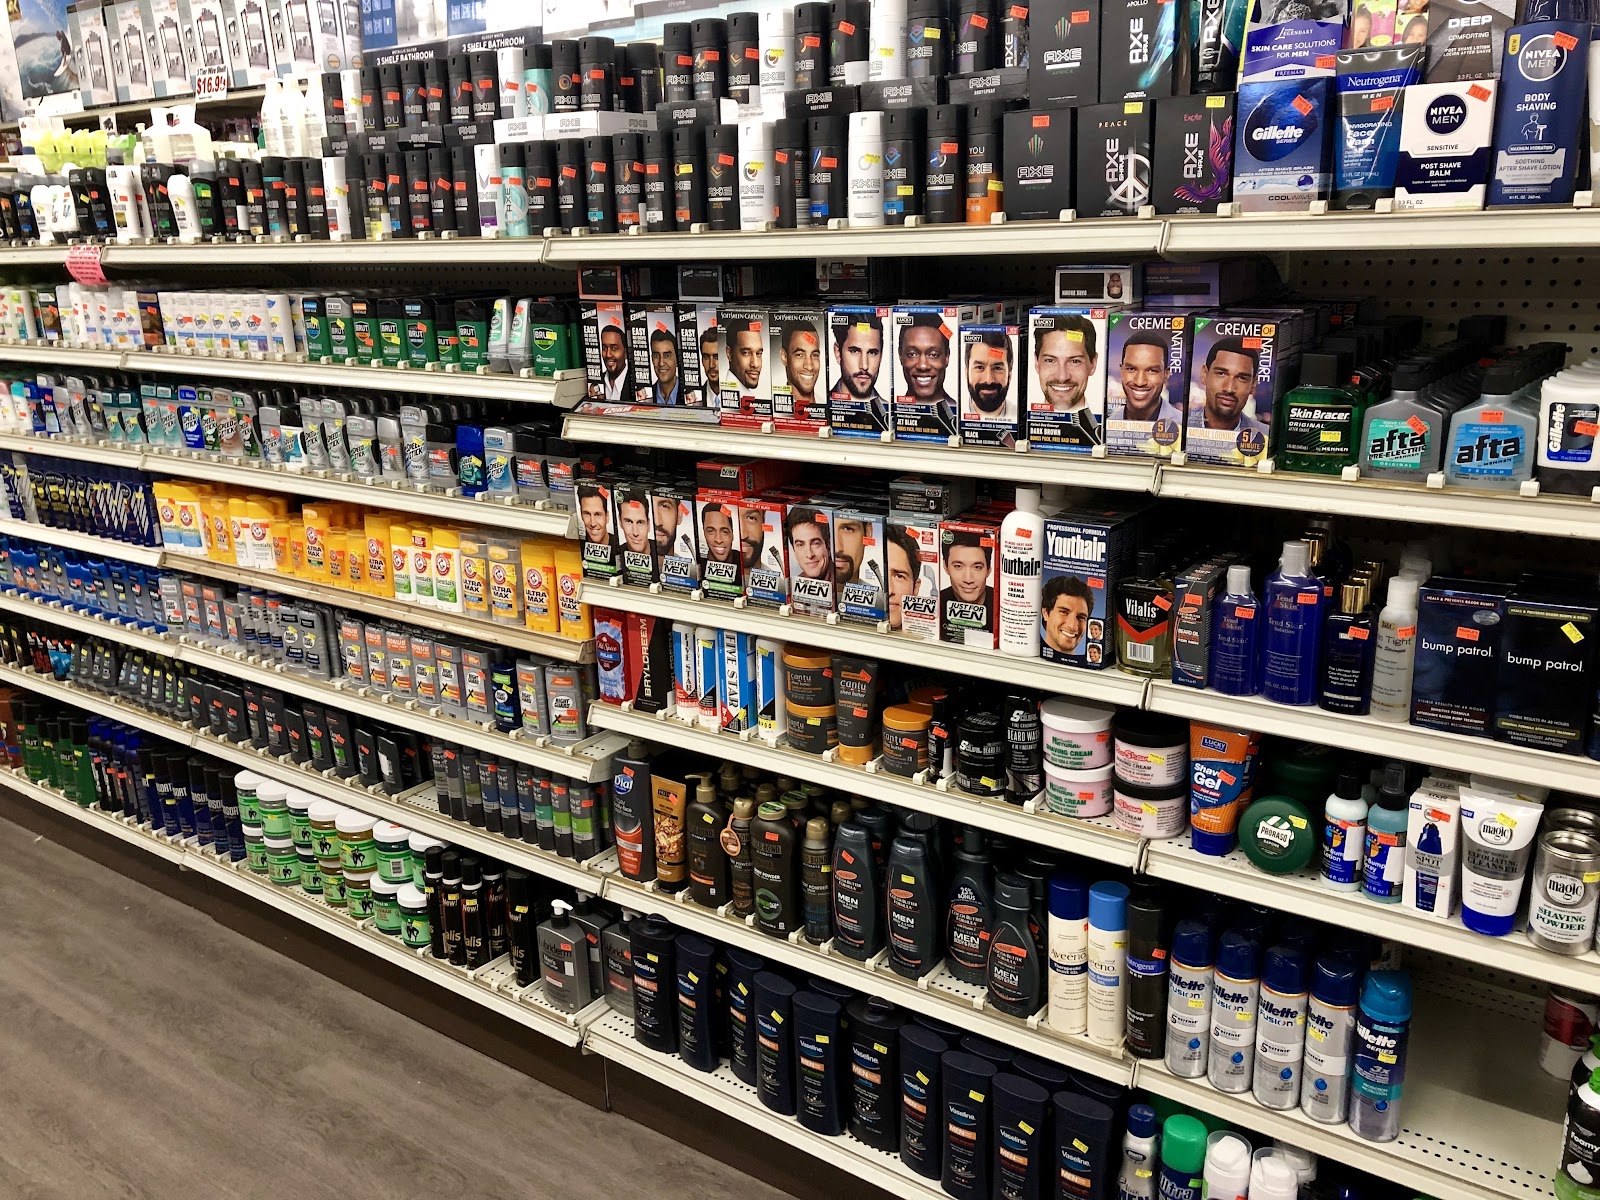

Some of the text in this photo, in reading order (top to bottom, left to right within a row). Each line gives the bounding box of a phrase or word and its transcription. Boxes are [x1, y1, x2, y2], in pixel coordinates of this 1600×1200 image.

[1448, 15, 1492, 28] DEEP
[1130, 18, 1144, 64] AXE
[1448, 32, 1490, 40] COMFORTING
[462, 44, 467, 52] 3
[487, 36, 525, 49] BATHROOM
[1251, 38, 1336, 52] SKIN CARE SOLUTIONS
[1044, 48, 1082, 64] AXE
[1292, 50, 1310, 58] MEN
[1525, 48, 1561, 58] NIVEA
[1527, 59, 1557, 68] MEN
[1347, 74, 1401, 88] Neutrogena
[884, 85, 912, 97] AXE
[1524, 93, 1550, 102] BODY
[806, 92, 832, 104] AXE
[1430, 106, 1463, 116] NIVEA
[1516, 102, 1556, 112] SHAVING
[1098, 120, 1128, 128] PEACE
[1432, 116, 1460, 124] MEN
[1252, 125, 1304, 141] Gillette
[1106, 138, 1119, 182] AXE
[1183, 132, 1199, 178] AXE
[1018, 164, 1054, 178] AXE
[1420, 162, 1438, 170] POST
[851, 179, 881, 189] AXE
[584, 326, 596, 334] EASY
[1129, 317, 1183, 330] CREME OF
[1215, 323, 1274, 336] CREME OF
[632, 328, 646, 336] EASY
[681, 328, 695, 338] EASY
[1170, 331, 1183, 374] NATURE
[1257, 338, 1274, 383] NATURE
[1290, 408, 1348, 420] Skin Bracer
[1549, 403, 1566, 452] Gillette
[1242, 431, 1249, 440] 5
[1370, 431, 1426, 455] afta
[1455, 435, 1520, 466] afta
[1047, 524, 1106, 537] PROFESSIONAL FORMULA
[1046, 530, 1106, 563] Youthair
[464, 585, 480, 593] MAX
[492, 586, 512, 594] ULTRA
[794, 584, 829, 597] MEN
[527, 595, 545, 603] MAX
[843, 594, 873, 605] MEN
[904, 596, 922, 604] JUST
[1276, 594, 1294, 602] Tend
[561, 602, 578, 610] MAX
[903, 603, 935, 613] MEN
[949, 602, 967, 610] JUST
[1126, 598, 1156, 618] Vitalis
[1279, 601, 1298, 610] Skin
[948, 609, 983, 620] MEN
[1268, 618, 1304, 629] Tend Skin
[1422, 638, 1494, 658] bump patrol.
[640, 618, 652, 697] BRYLCREEM
[1508, 652, 1584, 672] bump patrol.
[726, 634, 738, 708] FIVE STAR
[790, 672, 811, 682] cantu
[840, 680, 867, 691] cantu
[1007, 729, 1040, 742] BEARD WAS
[1205, 739, 1226, 749] LUCKY
[614, 774, 633, 790] Dial
[1194, 774, 1222, 790] Gel
[1461, 809, 1474, 817] NEW
[1260, 826, 1288, 842] PRORASO
[1482, 825, 1510, 841] magic
[1323, 851, 1341, 862] Lotion
[1416, 857, 1441, 866] SPOT
[1467, 850, 1518, 866] EXFOLIATING
[1467, 857, 1517, 873] CLEANSER
[960, 887, 973, 895] 25%
[1549, 879, 1582, 901] magic
[837, 892, 858, 905] MEN
[957, 893, 976, 901] BONUS
[1538, 906, 1586, 923] SHAVING
[1536, 914, 1585, 931] POWDER
[953, 931, 980, 945] MEN
[1051, 948, 1086, 961] Aveeno
[994, 966, 1019, 981] MEN
[1213, 995, 1244, 1012] FUSION
[1260, 1009, 1293, 1026] FUSION
[1366, 1043, 1394, 1054] SERIES
